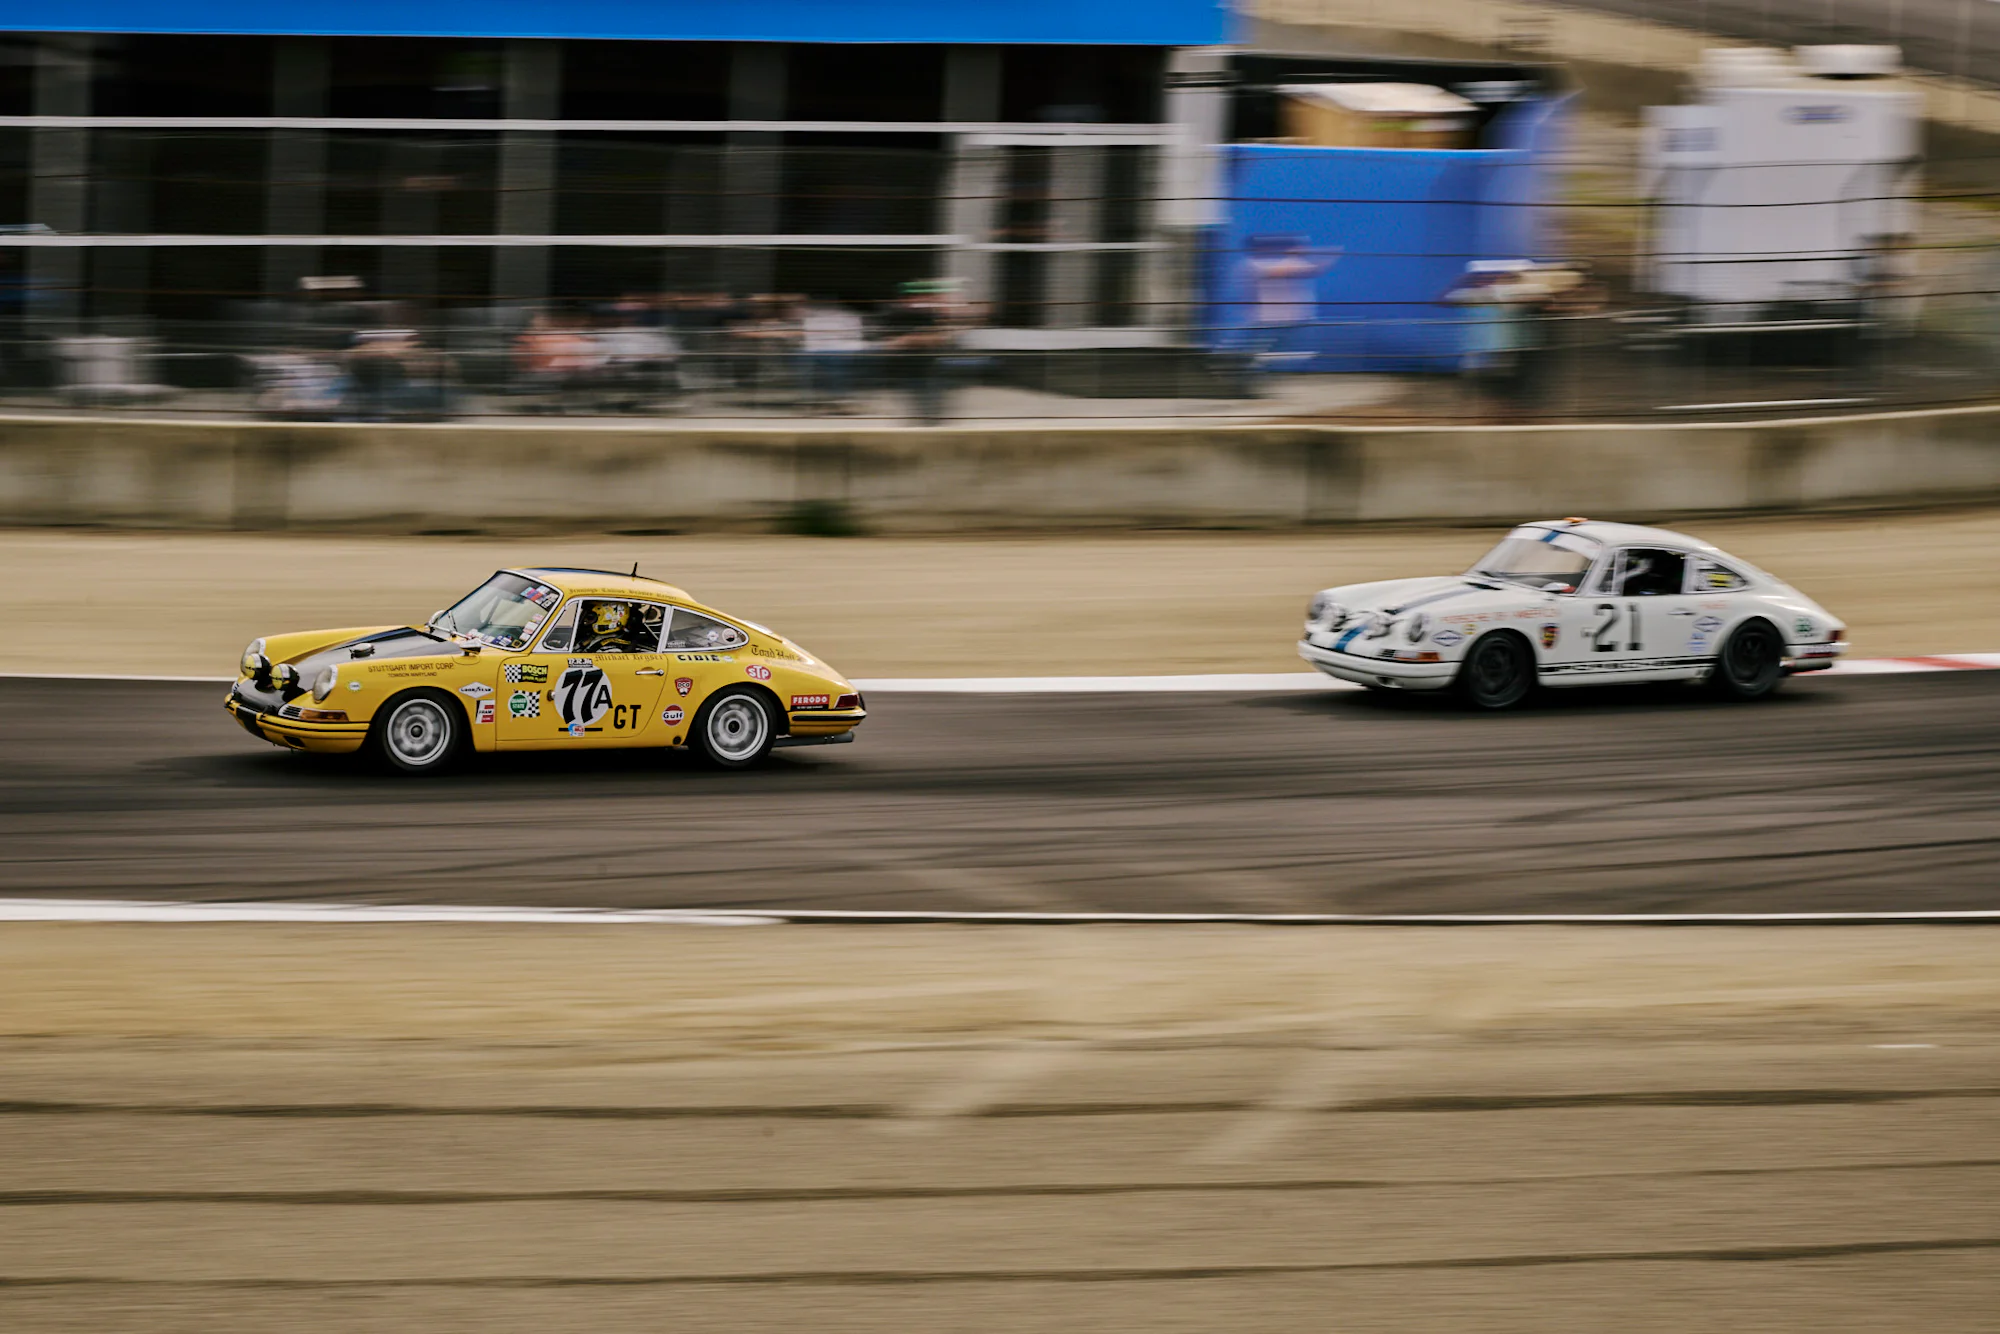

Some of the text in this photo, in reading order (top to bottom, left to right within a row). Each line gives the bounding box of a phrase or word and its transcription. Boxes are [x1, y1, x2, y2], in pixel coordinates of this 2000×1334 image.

[1592, 604, 1644, 652] 21
[752, 644, 776, 658] Toad
[594, 654, 630, 662] Michael
[368, 664, 406, 673] STUTTGART
[409, 663, 434, 671] IMPORT
[522, 665, 547, 675] BOSCH
[748, 665, 770, 680] STP
[793, 696, 828, 704] FERODO
[613, 704, 641, 730] GT
[662, 712, 684, 720] Gulf
